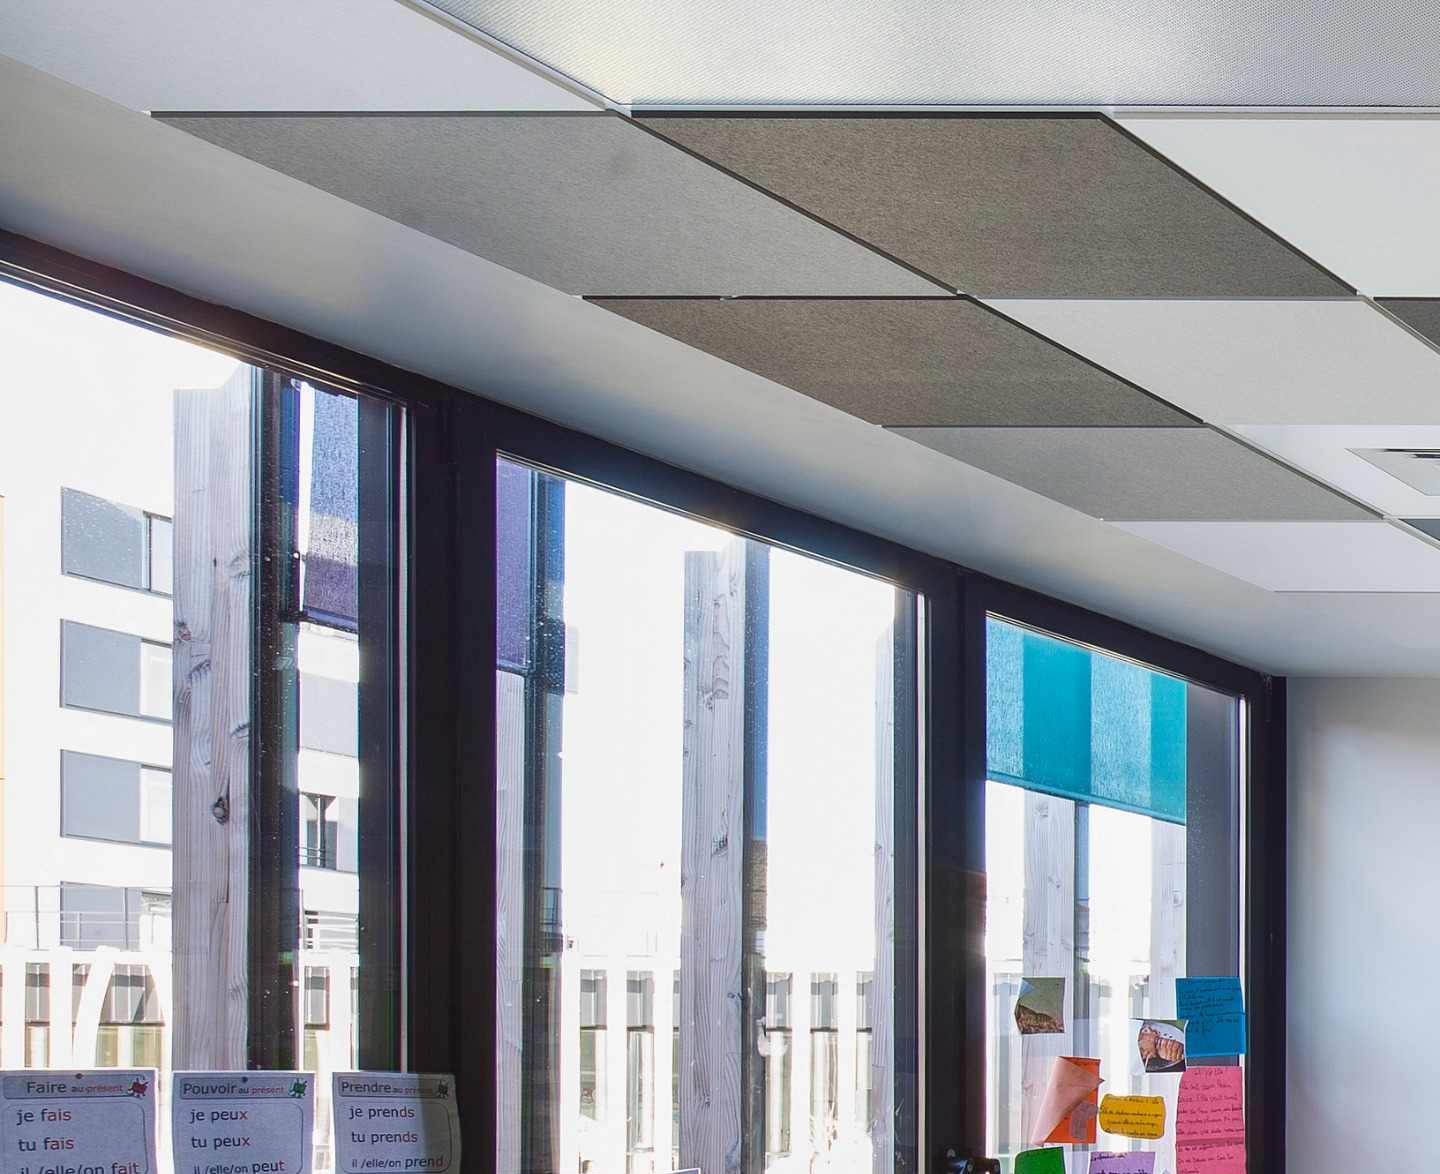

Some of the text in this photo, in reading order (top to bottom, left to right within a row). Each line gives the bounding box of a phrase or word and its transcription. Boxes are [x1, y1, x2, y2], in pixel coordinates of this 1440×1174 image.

[27, 1082, 67, 1094] Faire
[86, 1083, 123, 1093] présent
[183, 1082, 237, 1097] Pouvoir
[251, 1085, 284, 1095] présent
[341, 1081, 391, 1093] Prendre
[16, 1108, 71, 1124] je fais
[190, 1109, 248, 1123] je peux
[19, 1137, 74, 1151] tu fais
[191, 1136, 250, 1149] tu peux
[111, 1162, 139, 1174] fait
[193, 1159, 285, 1174] il /elle/on peut
